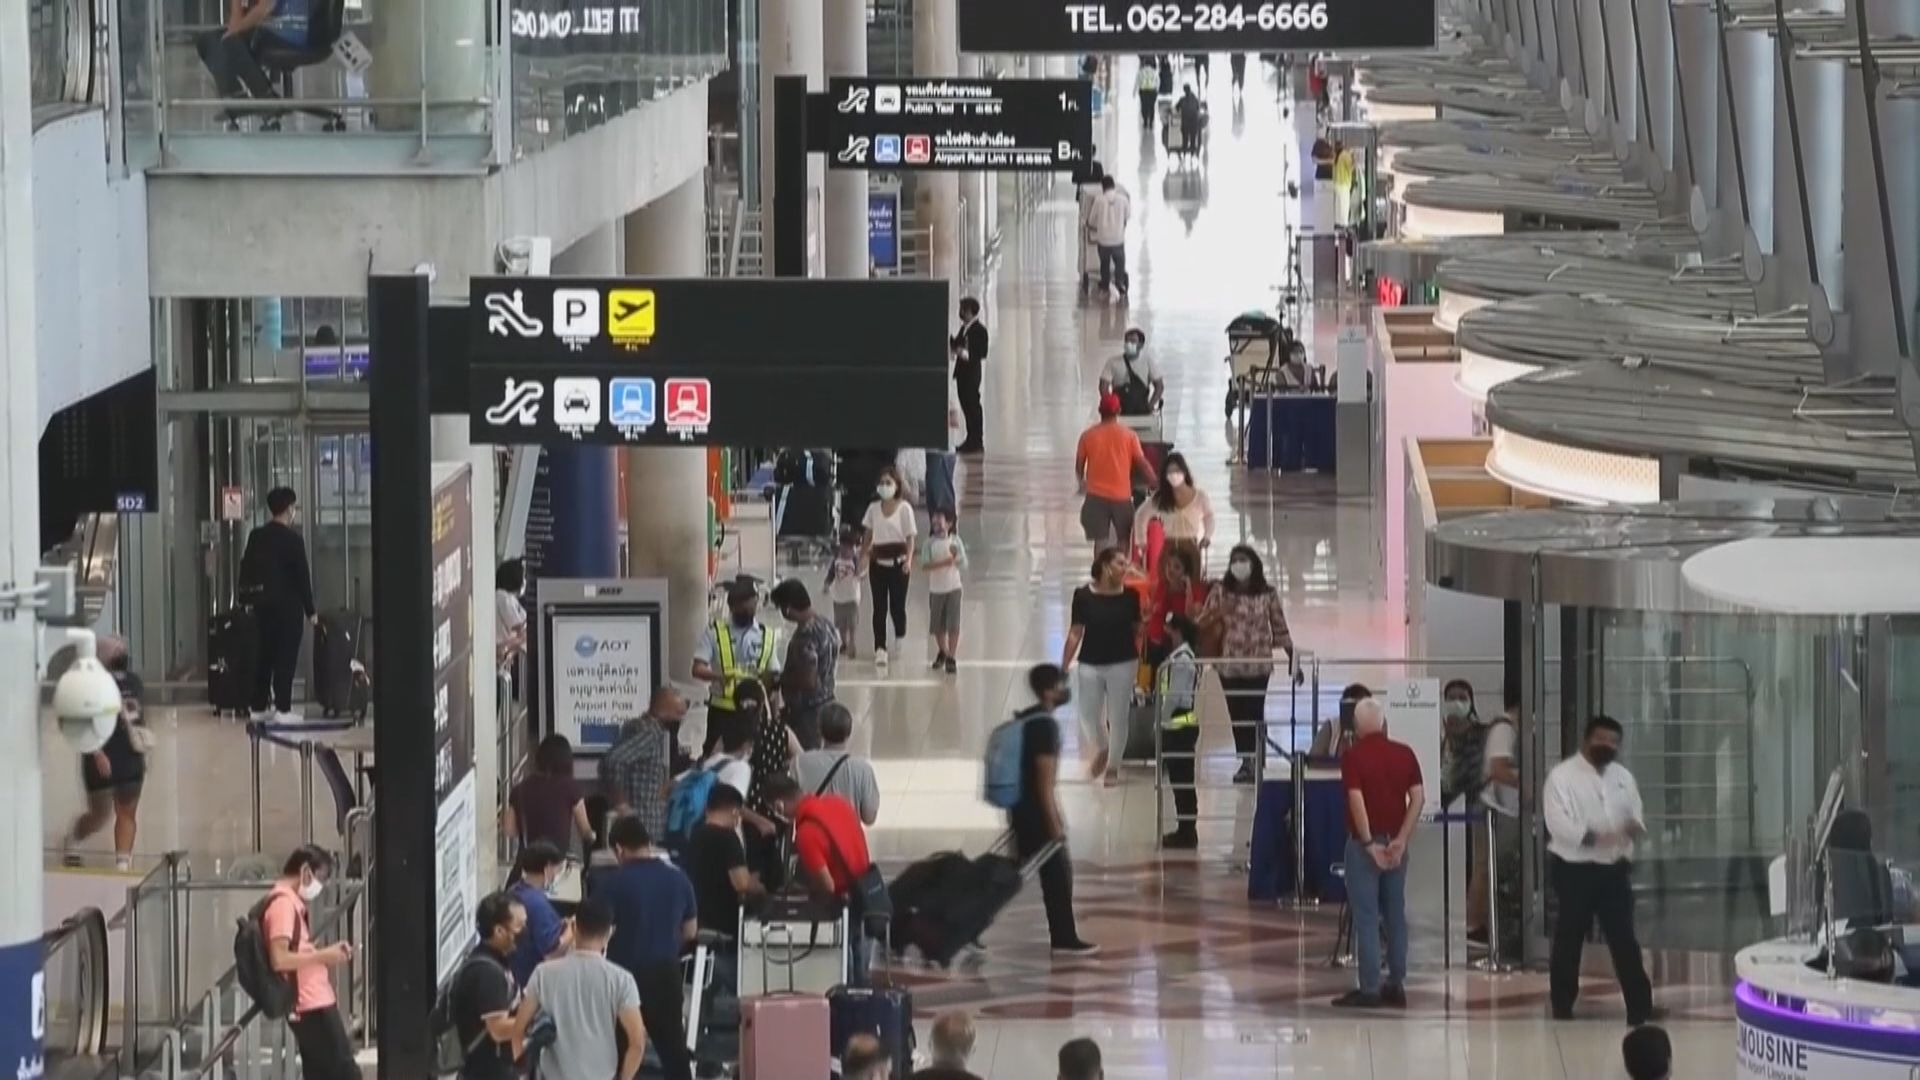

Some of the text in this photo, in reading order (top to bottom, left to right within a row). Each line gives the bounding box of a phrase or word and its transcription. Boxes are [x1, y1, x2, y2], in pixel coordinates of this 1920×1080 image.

[1065, 3, 1328, 32] TEL. 062-284-6666
[117, 496, 143, 510] SD2
[600, 639, 632, 651] AOT
